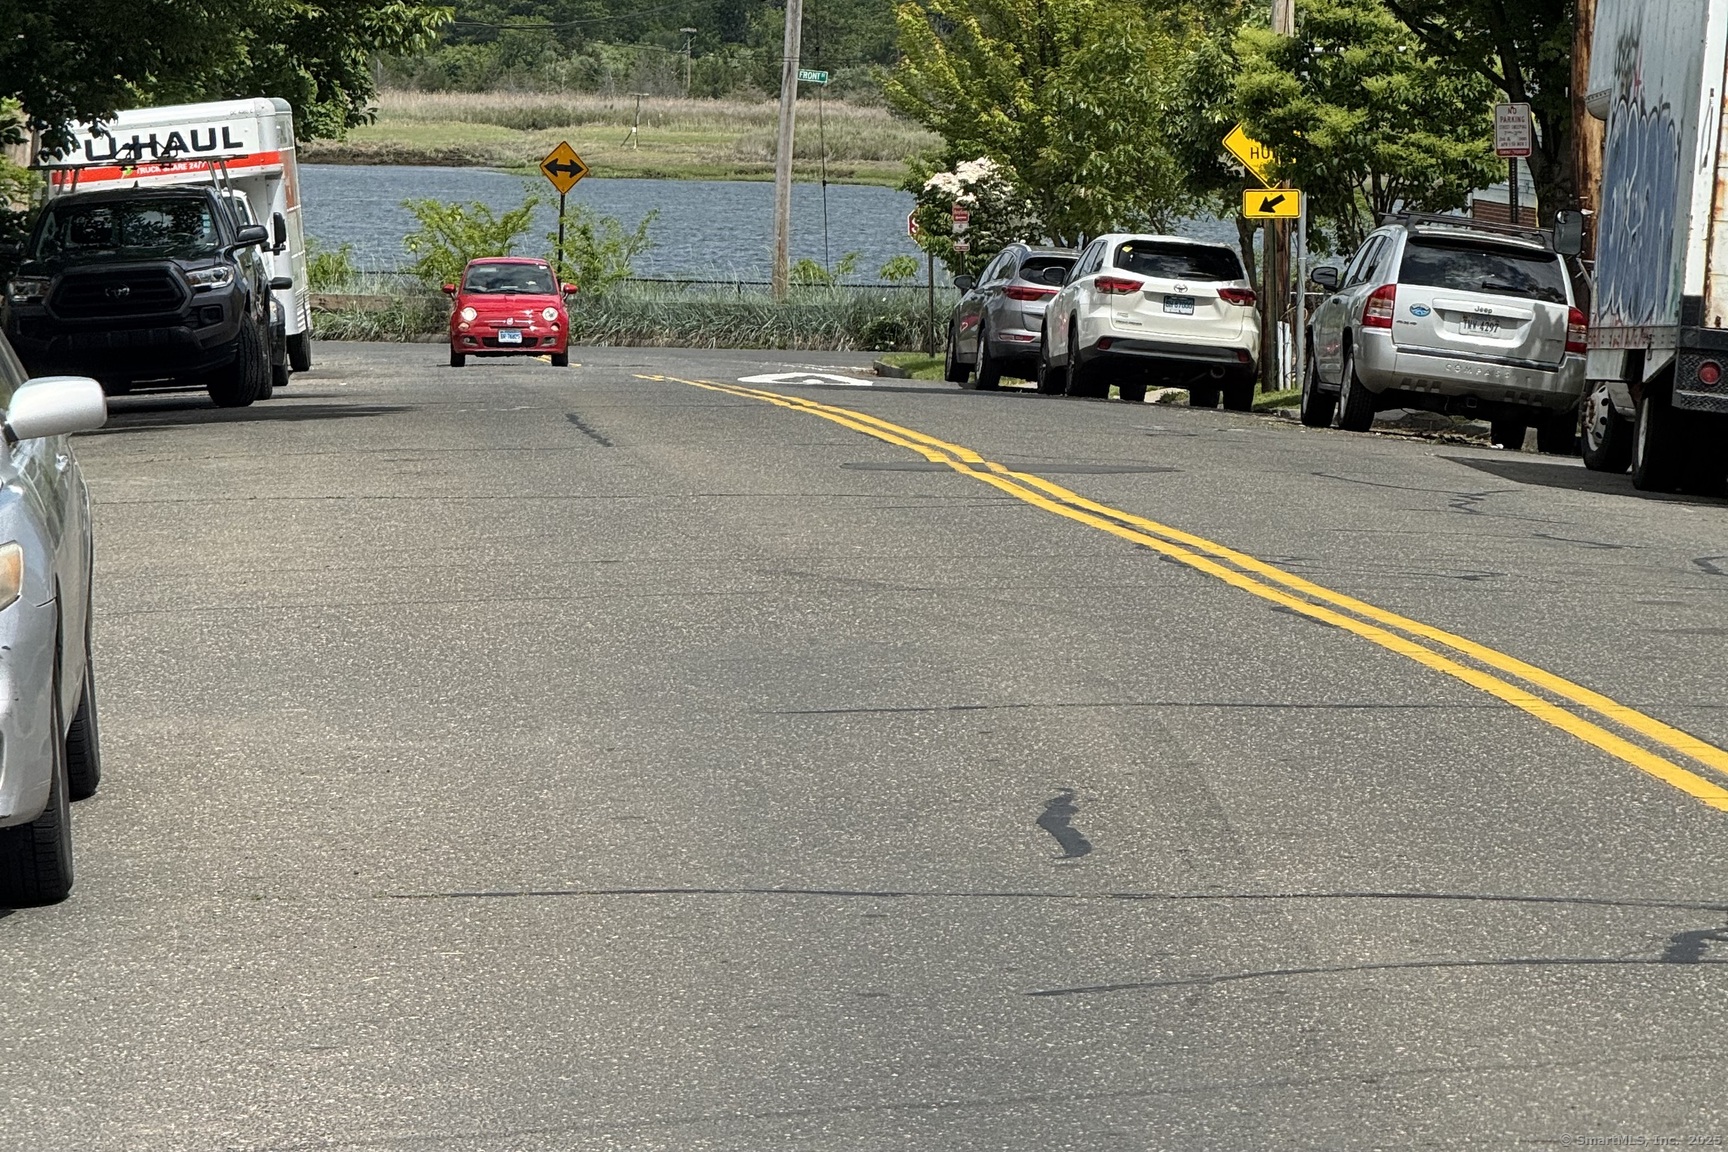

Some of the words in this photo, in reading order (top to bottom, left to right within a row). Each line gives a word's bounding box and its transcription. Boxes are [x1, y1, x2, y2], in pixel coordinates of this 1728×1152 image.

[799, 71, 820, 80] FRONT
[1475, 306, 1493, 315] Jeep
[1445, 363, 1511, 379] COMPASS
